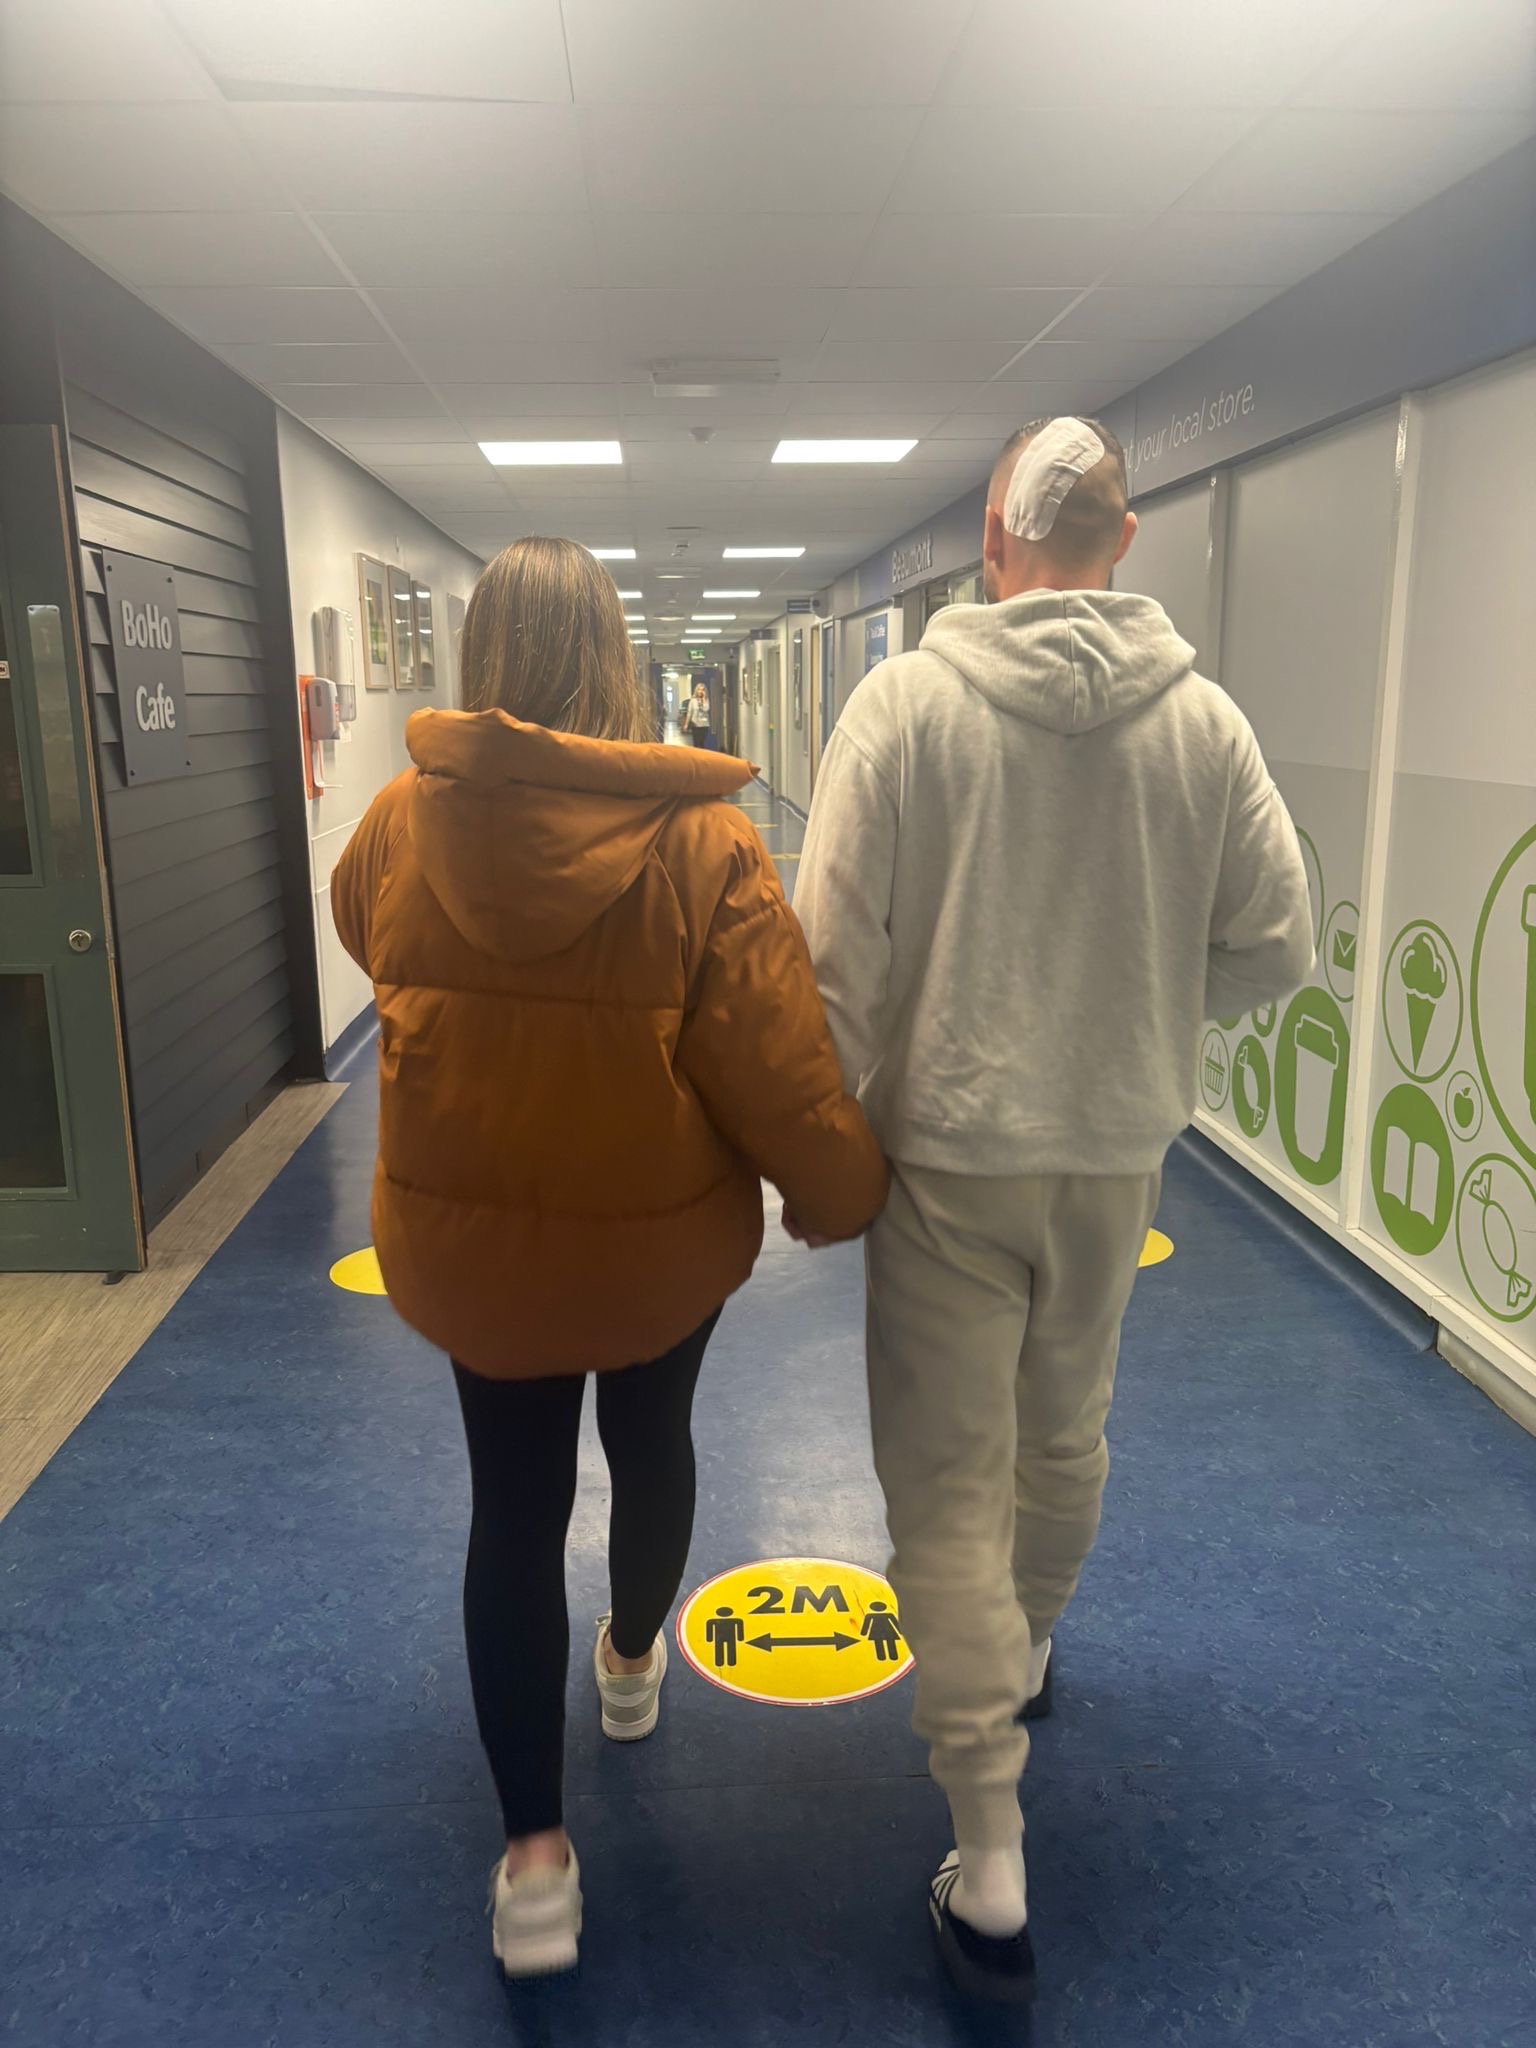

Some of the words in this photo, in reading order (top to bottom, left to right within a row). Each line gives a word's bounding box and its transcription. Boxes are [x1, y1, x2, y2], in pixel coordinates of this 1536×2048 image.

[1134, 428, 1167, 473] your
[1168, 397, 1206, 450] local
[1207, 384, 1255, 431] store.
[121, 599, 173, 650] BoHo
[135, 682, 176, 731] Cafe
[747, 1584, 849, 1615] 2M
